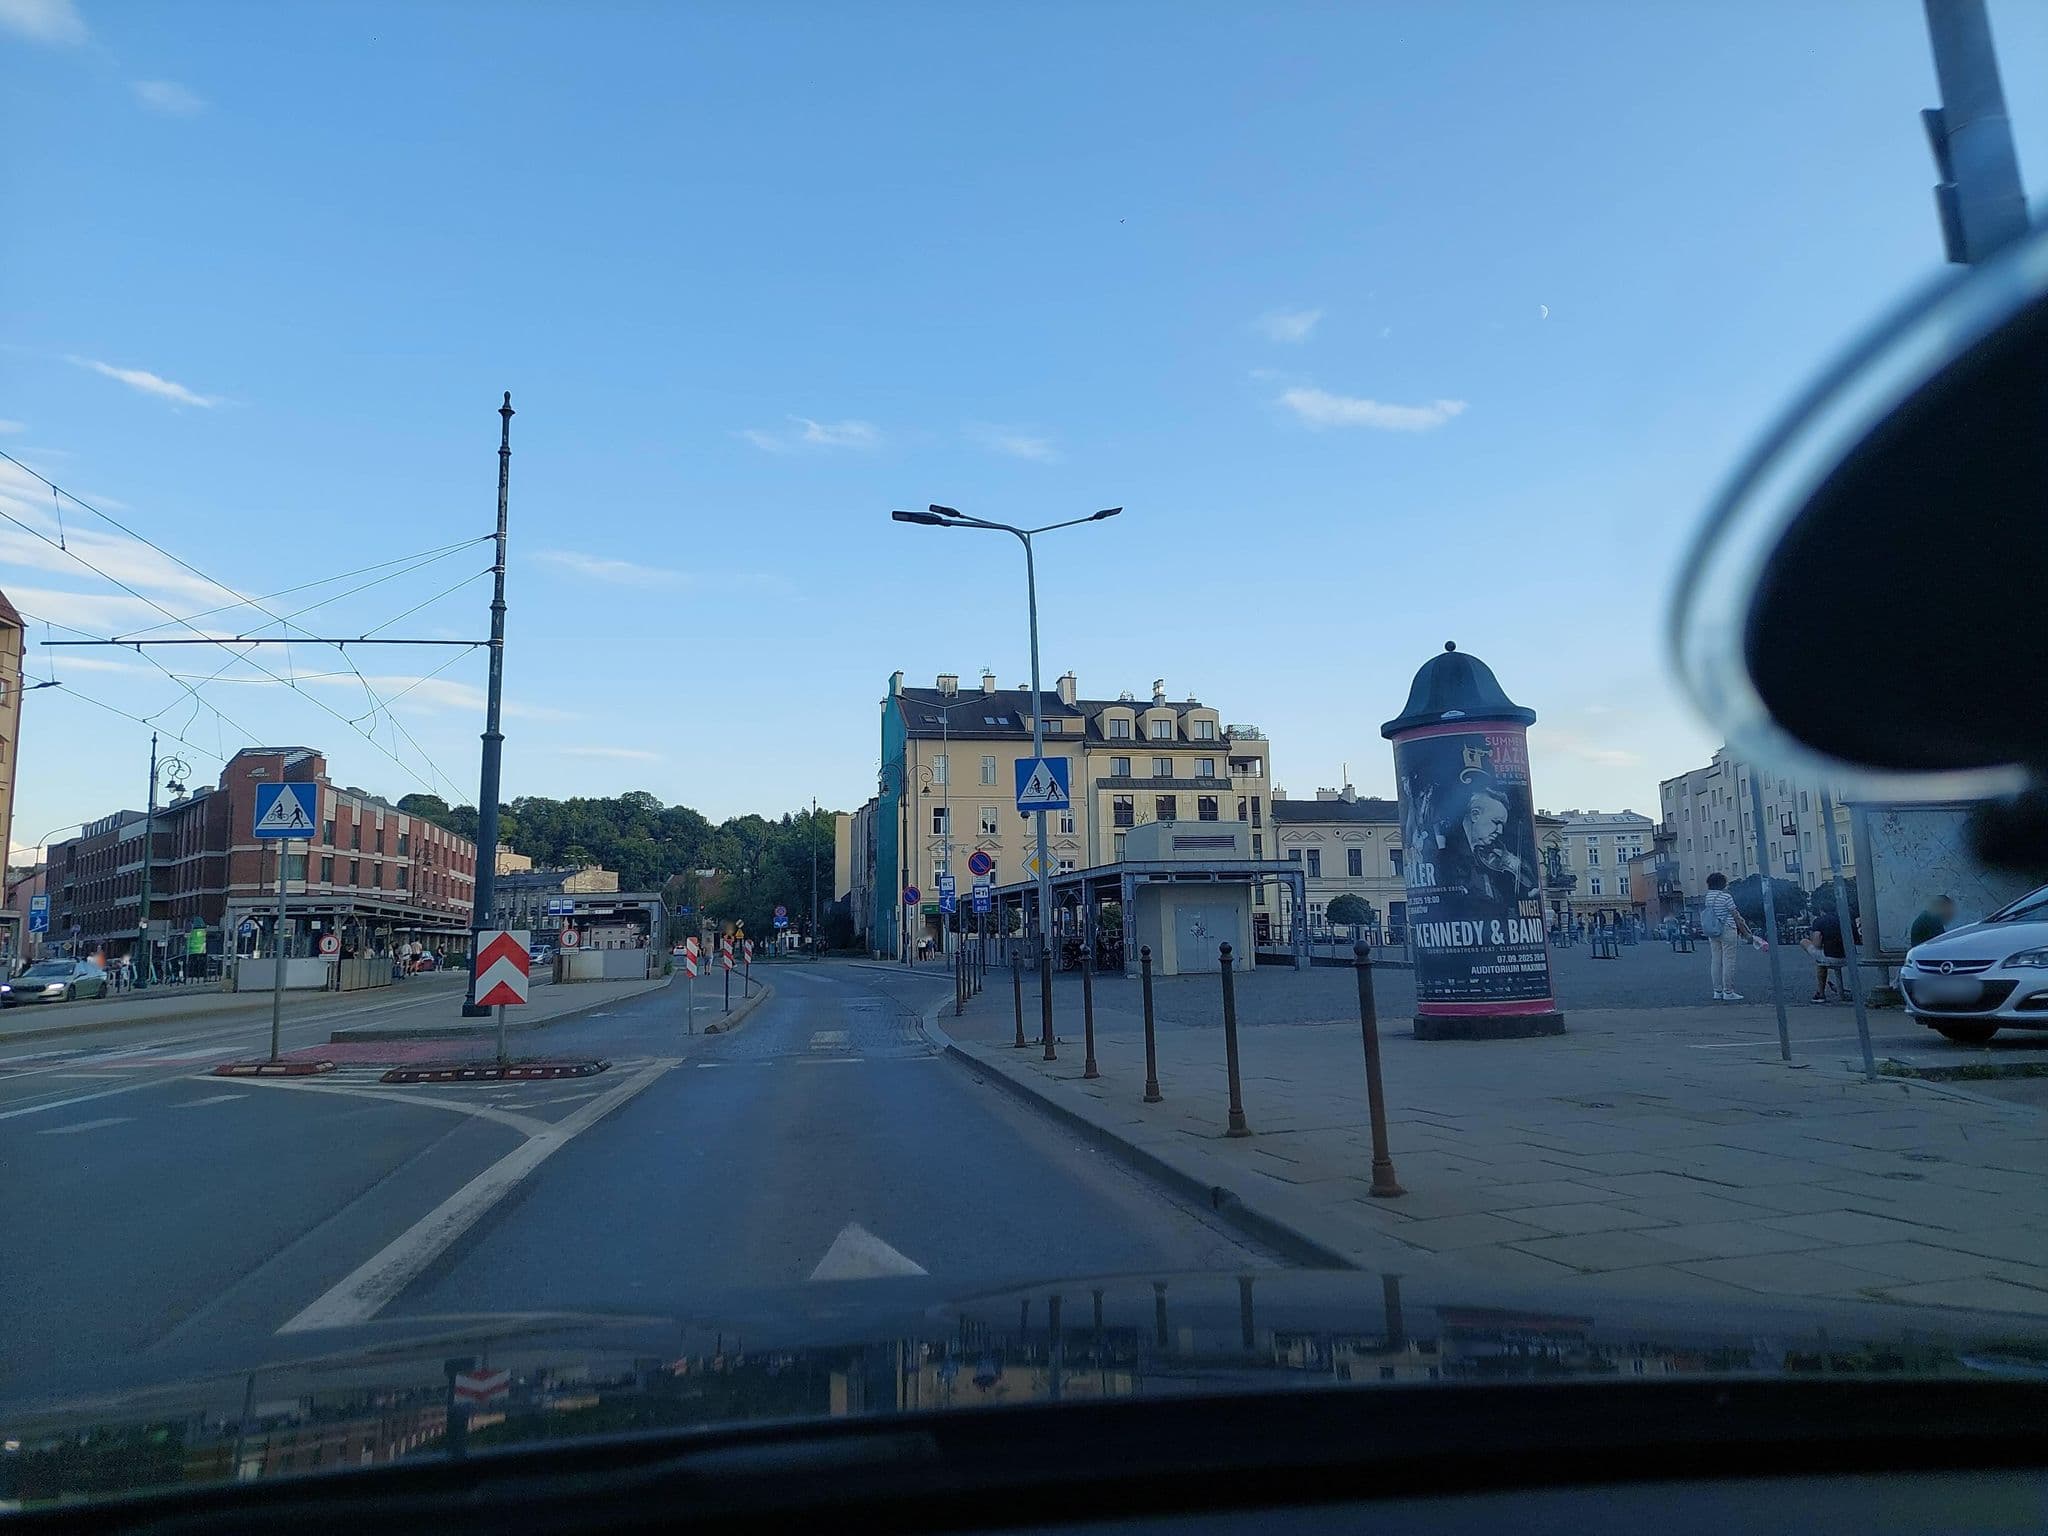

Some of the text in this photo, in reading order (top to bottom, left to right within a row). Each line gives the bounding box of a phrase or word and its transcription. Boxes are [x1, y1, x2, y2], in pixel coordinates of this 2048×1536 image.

[1518, 900, 1541, 917] NIGEL
[1416, 918, 1543, 948] KENNEDY & BAND
[1471, 964, 1520, 975] AUDITORIUM
